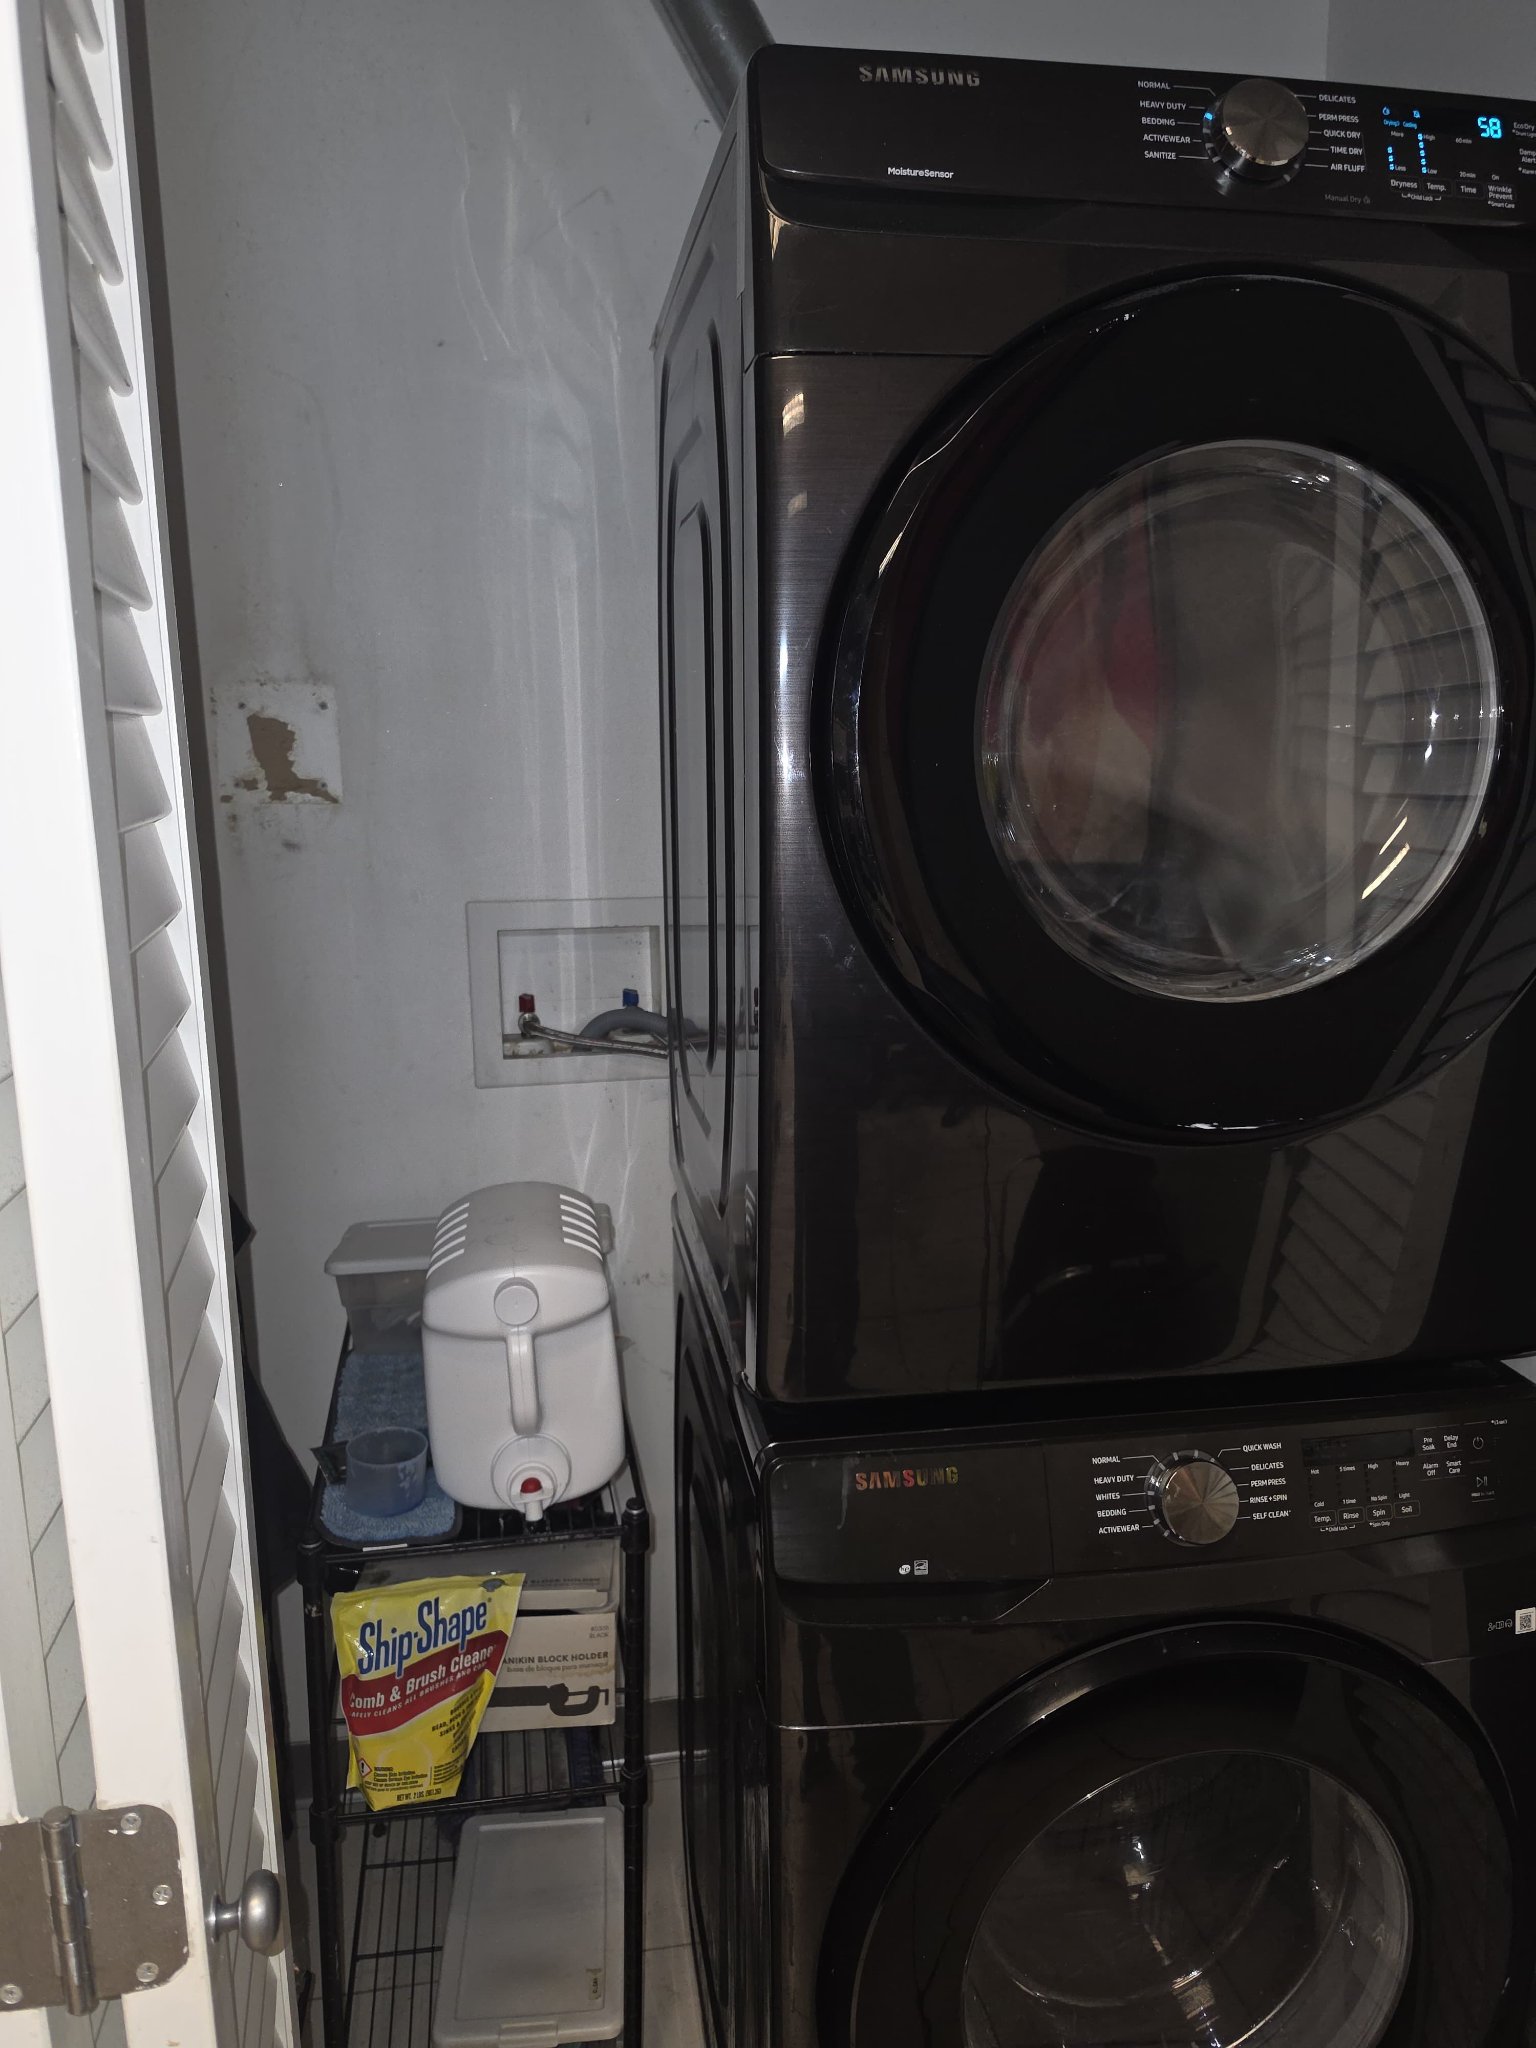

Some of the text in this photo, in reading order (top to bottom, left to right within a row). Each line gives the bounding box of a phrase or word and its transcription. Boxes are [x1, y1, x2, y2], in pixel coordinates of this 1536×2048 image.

[859, 64, 980, 87] SAMSUNG
[1138, 80, 1170, 89] NORMAL
[1319, 94, 1356, 104] DELICATES
[1140, 101, 1186, 111] HEAVY DUTY
[1141, 117, 1175, 126] BEDDING
[1319, 113, 1359, 123] PERM PRESS
[1477, 116, 1502, 139] 58
[1143, 134, 1191, 144] ACTIVEWEAR
[1323, 129, 1361, 140] QUICK DRY
[1144, 151, 1176, 160] SANITIZE
[1330, 146, 1363, 156] TIME DRY
[1331, 163, 1365, 173] AIR FLUFF
[1391, 179, 1418, 189] Dryness
[1427, 182, 1447, 192] Temp.
[1488, 185, 1512, 193] Wrinkle
[1460, 185, 1477, 194] Time
[1325, 194, 1349, 203] Manual
[1489, 192, 1513, 200] Prevent
[1243, 1442, 1282, 1452] QUICK WASH
[1092, 1455, 1120, 1465] NORMAL
[1251, 1461, 1284, 1471] DELICATES
[855, 1466, 959, 1491] SAMSUNG
[1094, 1475, 1134, 1484] HEAVY DUTY
[1251, 1478, 1286, 1488] PERM PRESS
[1096, 1492, 1120, 1501] WHITES
[1097, 1508, 1127, 1518] BEDDING
[1373, 1508, 1386, 1517] Spin
[1401, 1505, 1412, 1513] Soil
[1253, 1511, 1267, 1520] SELF
[1314, 1515, 1331, 1524] Temp.
[1343, 1511, 1359, 1520] Rinse
[1099, 1524, 1140, 1534] ACTIVEWEAR
[538, 1654, 569, 1663] BLOCK
[571, 1651, 609, 1662] HOLDER
[390, 1685, 401, 1702] &
[406, 1664, 446, 1695] Brush
[450, 1645, 494, 1673] Cleane
[374, 1703, 402, 1717] CLEANS
[405, 1695, 417, 1705] ALL
[456, 1668, 471, 1680] AND
